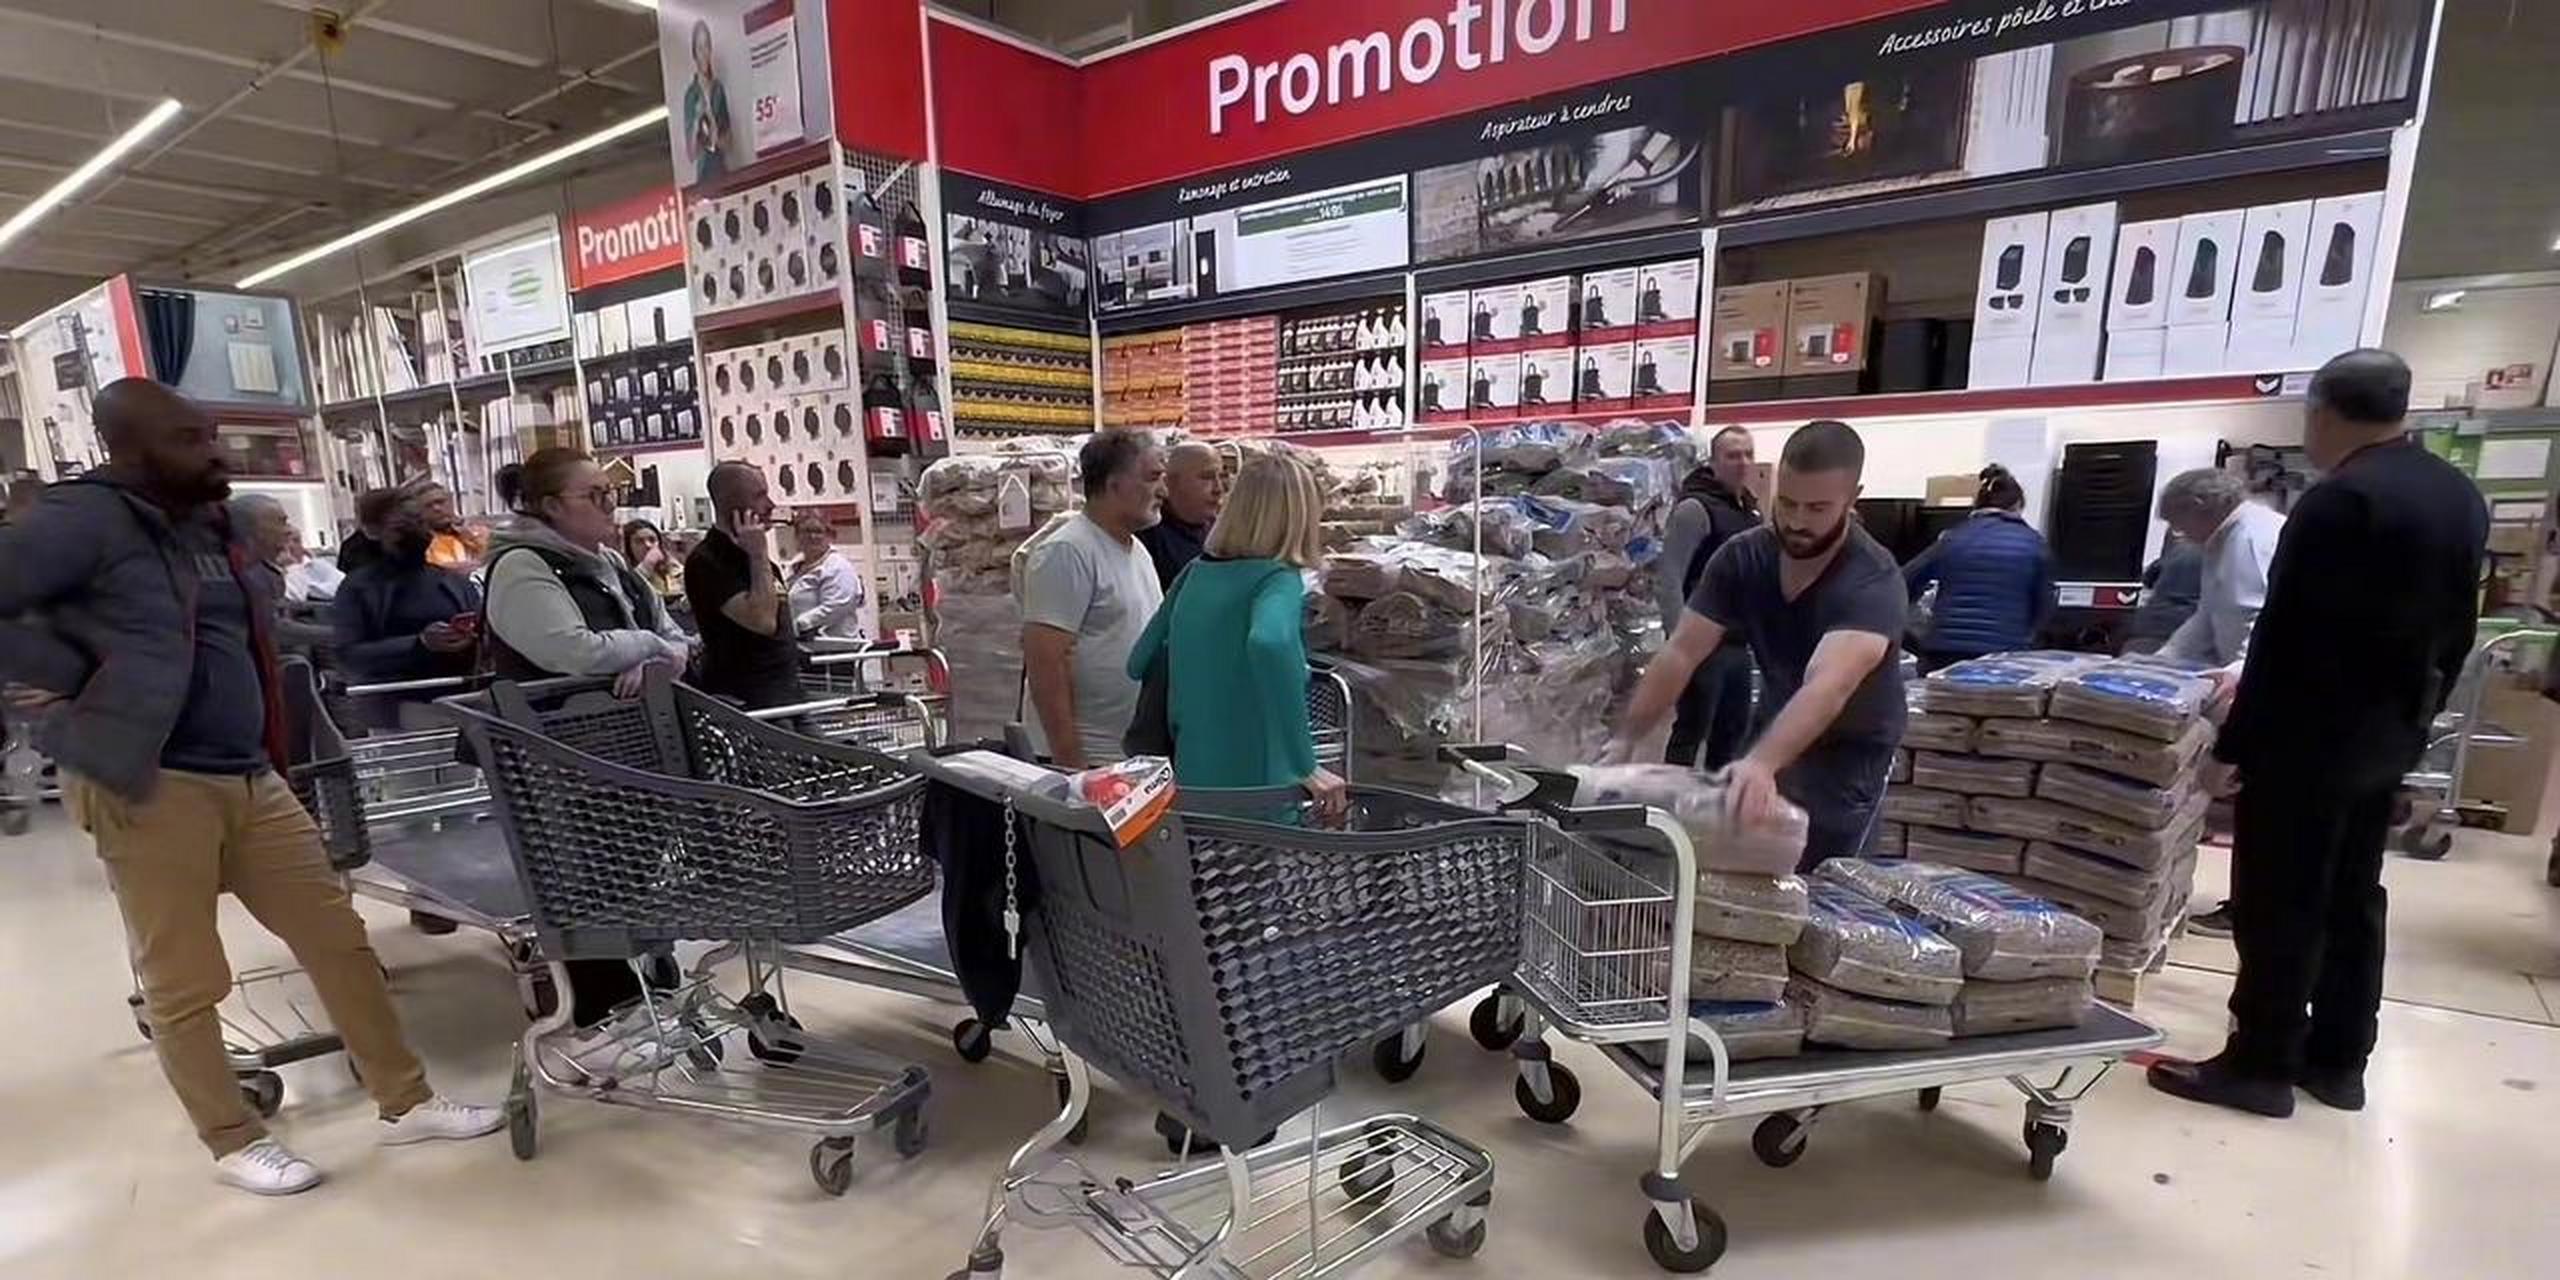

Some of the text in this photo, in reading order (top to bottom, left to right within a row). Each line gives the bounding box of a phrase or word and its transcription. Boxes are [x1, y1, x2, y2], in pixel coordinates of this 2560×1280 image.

[1878, 17, 1993, 56] Accessoires
[1209, 0, 1628, 135] Promotion
[1480, 111, 1556, 141] Aspirateur
[1572, 92, 1632, 121] cendres
